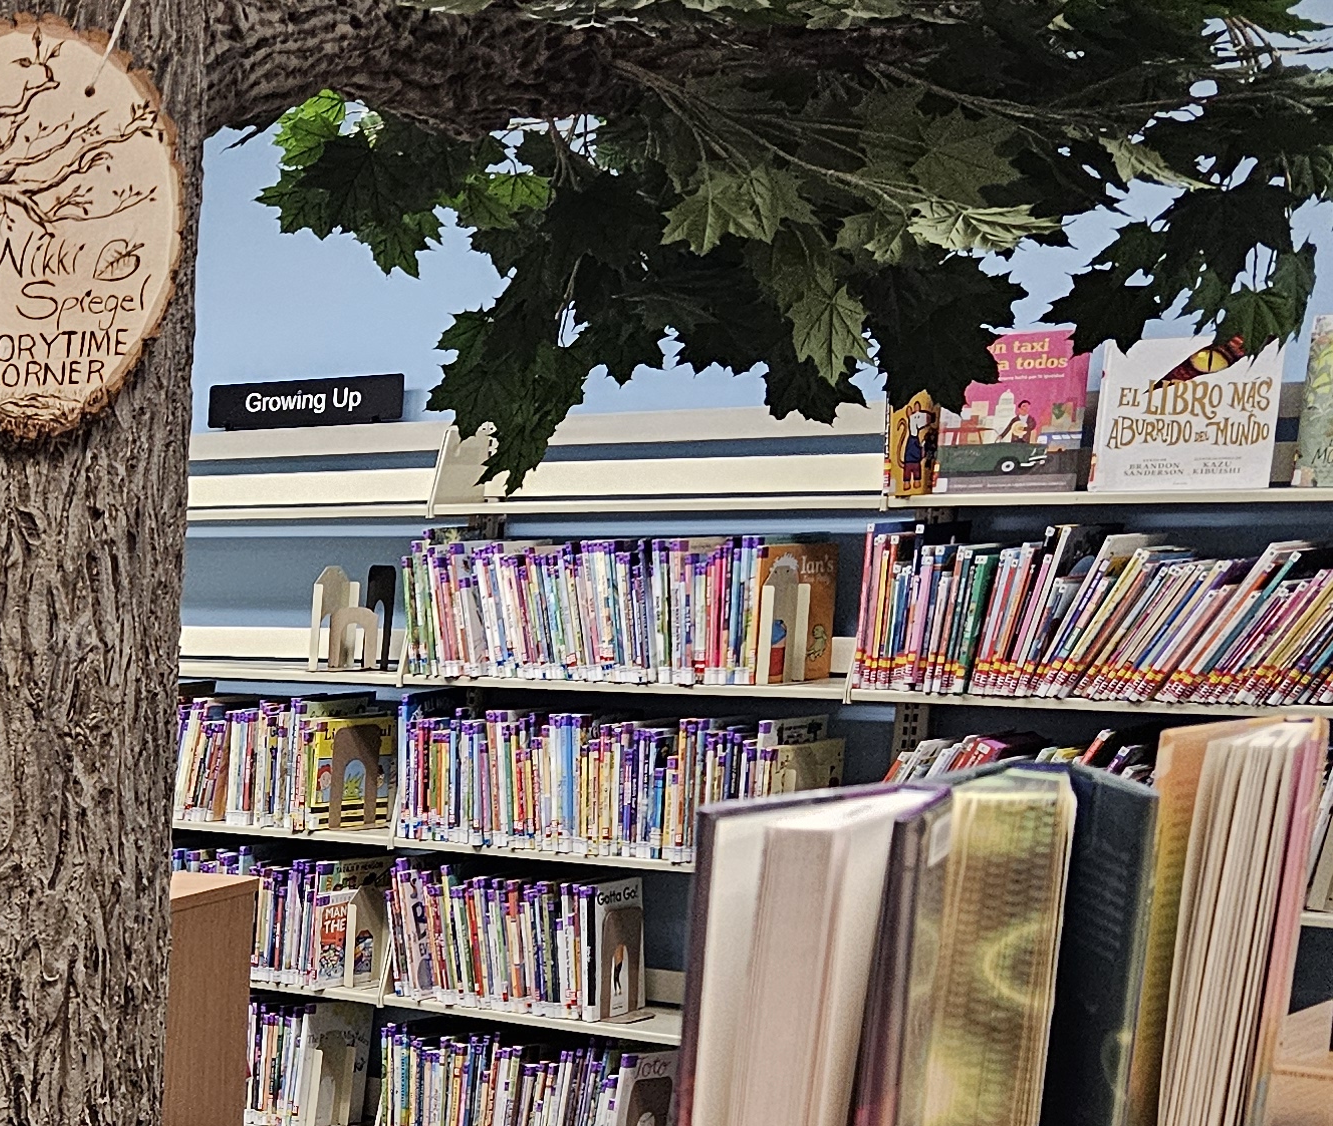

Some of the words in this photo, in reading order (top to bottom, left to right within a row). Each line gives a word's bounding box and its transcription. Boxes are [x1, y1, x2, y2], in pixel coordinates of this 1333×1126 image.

[16, 274, 153, 331] Spiegel
[1013, 337, 1049, 354] taxi
[1016, 355, 1068, 370] todos
[244, 391, 327, 415] Growing
[332, 387, 362, 411] Up
[1118, 387, 1140, 407] EL
[1146, 379, 1223, 419] LIBRO
[1225, 376, 1273, 413] MÁS
[1105, 417, 1192, 450] ABURRIDO
[1210, 413, 1270, 447] MUNDO
[1129, 462, 1181, 470] BRANDON
[800, 555, 834, 574] Ian's
[597, 891, 617, 907] Gotta
[618, 887, 639, 902] Go!
[636, 1059, 670, 1076] Toto
